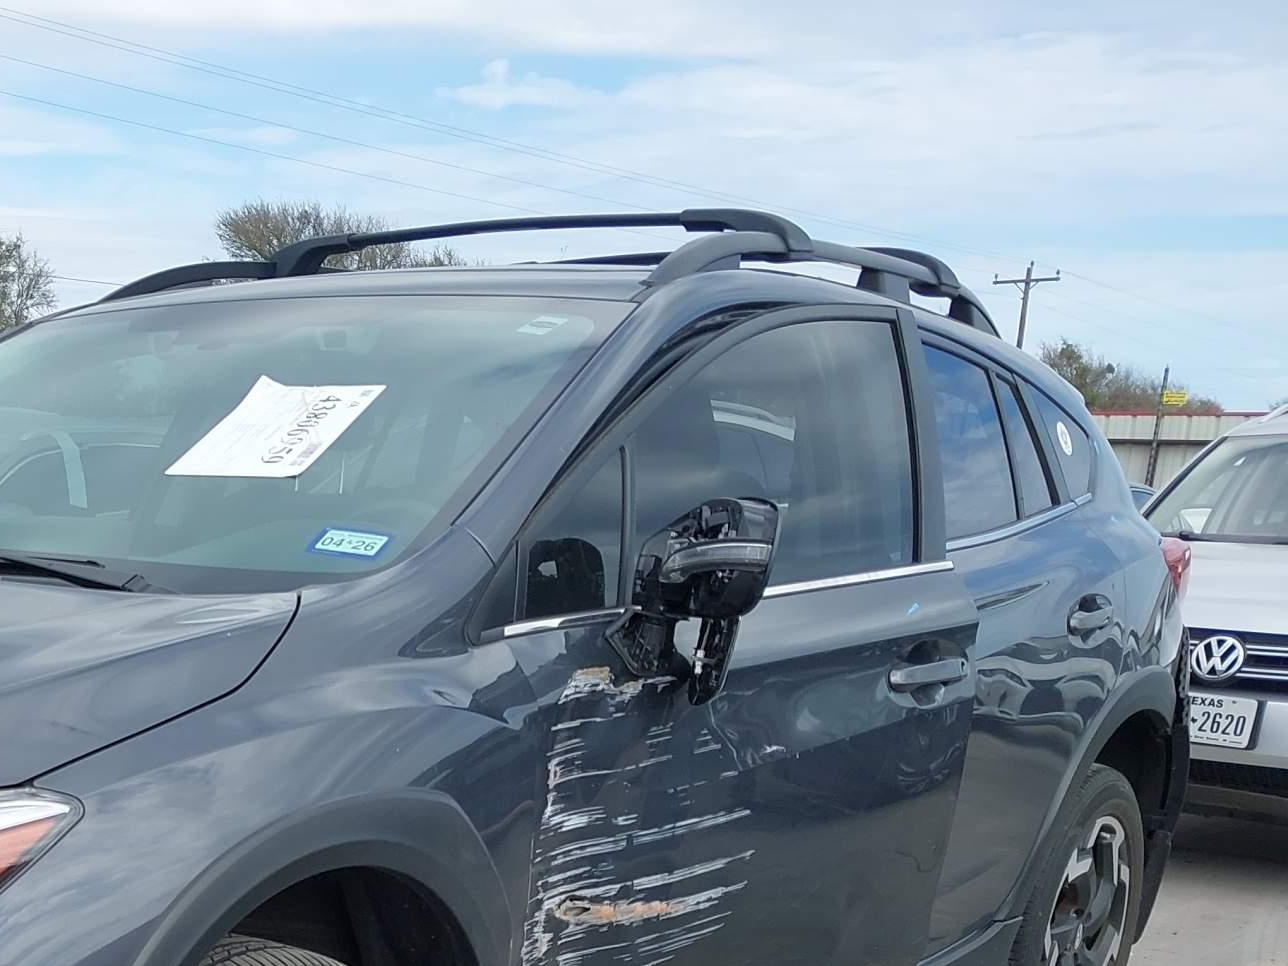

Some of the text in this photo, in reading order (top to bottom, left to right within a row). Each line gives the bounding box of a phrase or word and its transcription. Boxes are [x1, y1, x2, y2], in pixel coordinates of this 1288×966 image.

[261, 395, 342, 464] 43806959
[321, 537, 377, 551] 04 26
[1190, 696, 1224, 708] EXAS
[1197, 711, 1247, 737] 2620
